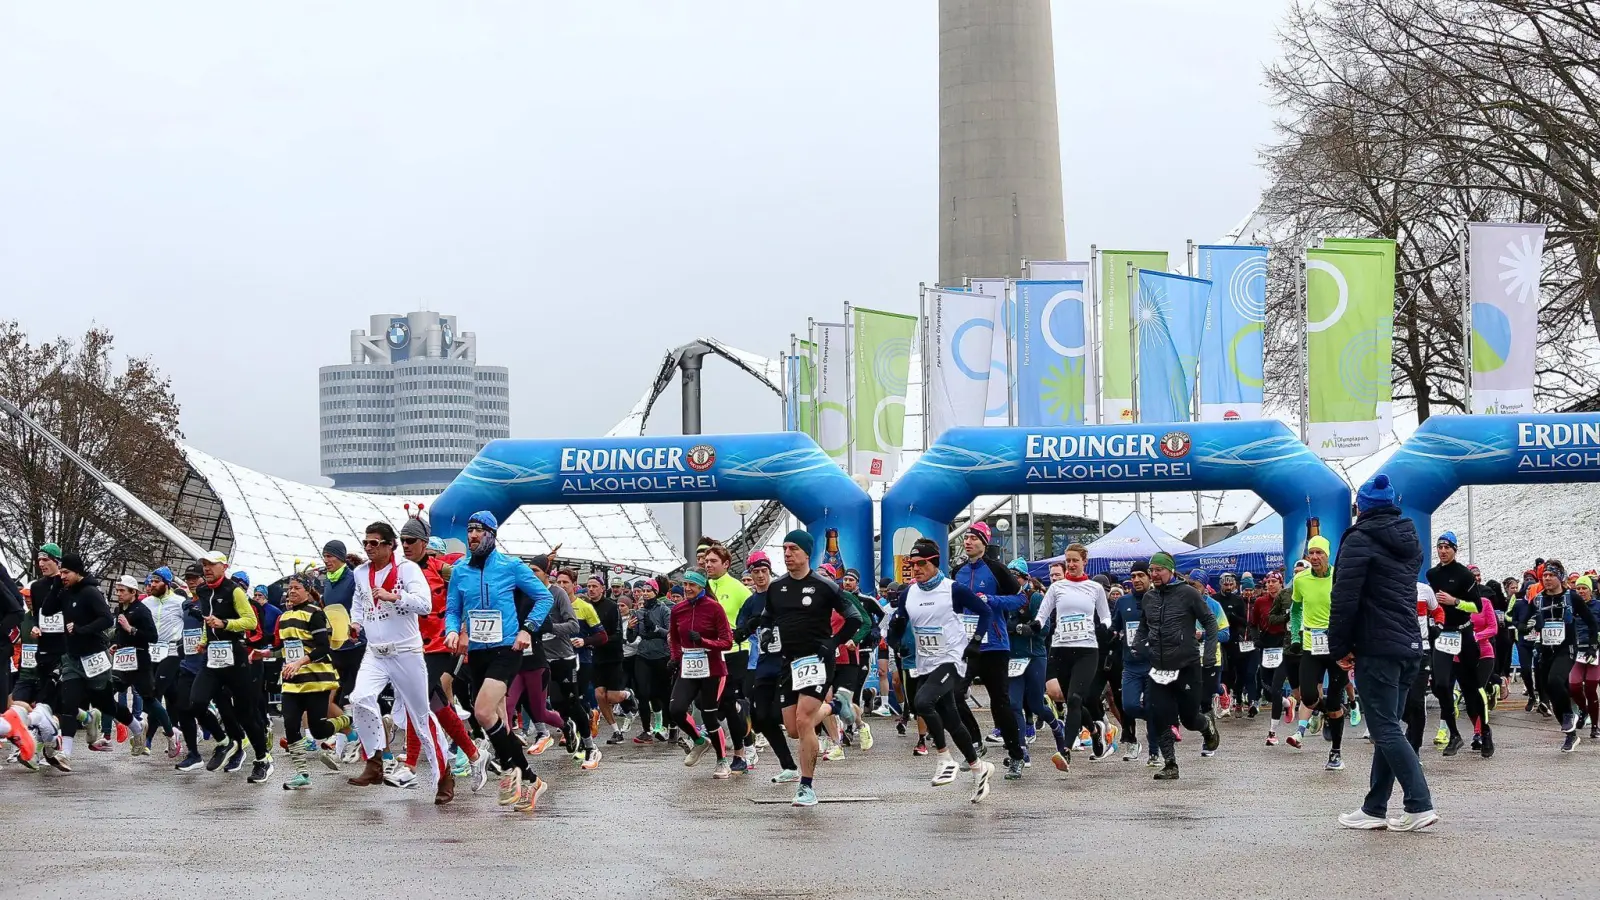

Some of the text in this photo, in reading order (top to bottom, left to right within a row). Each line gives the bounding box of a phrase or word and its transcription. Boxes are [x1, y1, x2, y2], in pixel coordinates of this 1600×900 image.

[1026, 434, 1159, 461] ERDINGER
[560, 447, 684, 474] ERDINGER
[1026, 462, 1191, 480] ALKOHOLFREI
[561, 474, 717, 492] ALKOHOLFREI
[1200, 557, 1230, 565] ERDINGER
[474, 619, 495, 631] 277
[1062, 621, 1085, 633] 1151
[1543, 628, 1562, 637] 1417
[919, 635, 939, 647] 611
[1437, 636, 1460, 647] 1146
[23, 651, 36, 660] 119
[115, 653, 136, 664] 2076
[211, 649, 227, 659] 329
[86, 655, 104, 668] 455
[686, 659, 704, 669] 330
[797, 664, 819, 679] 673
